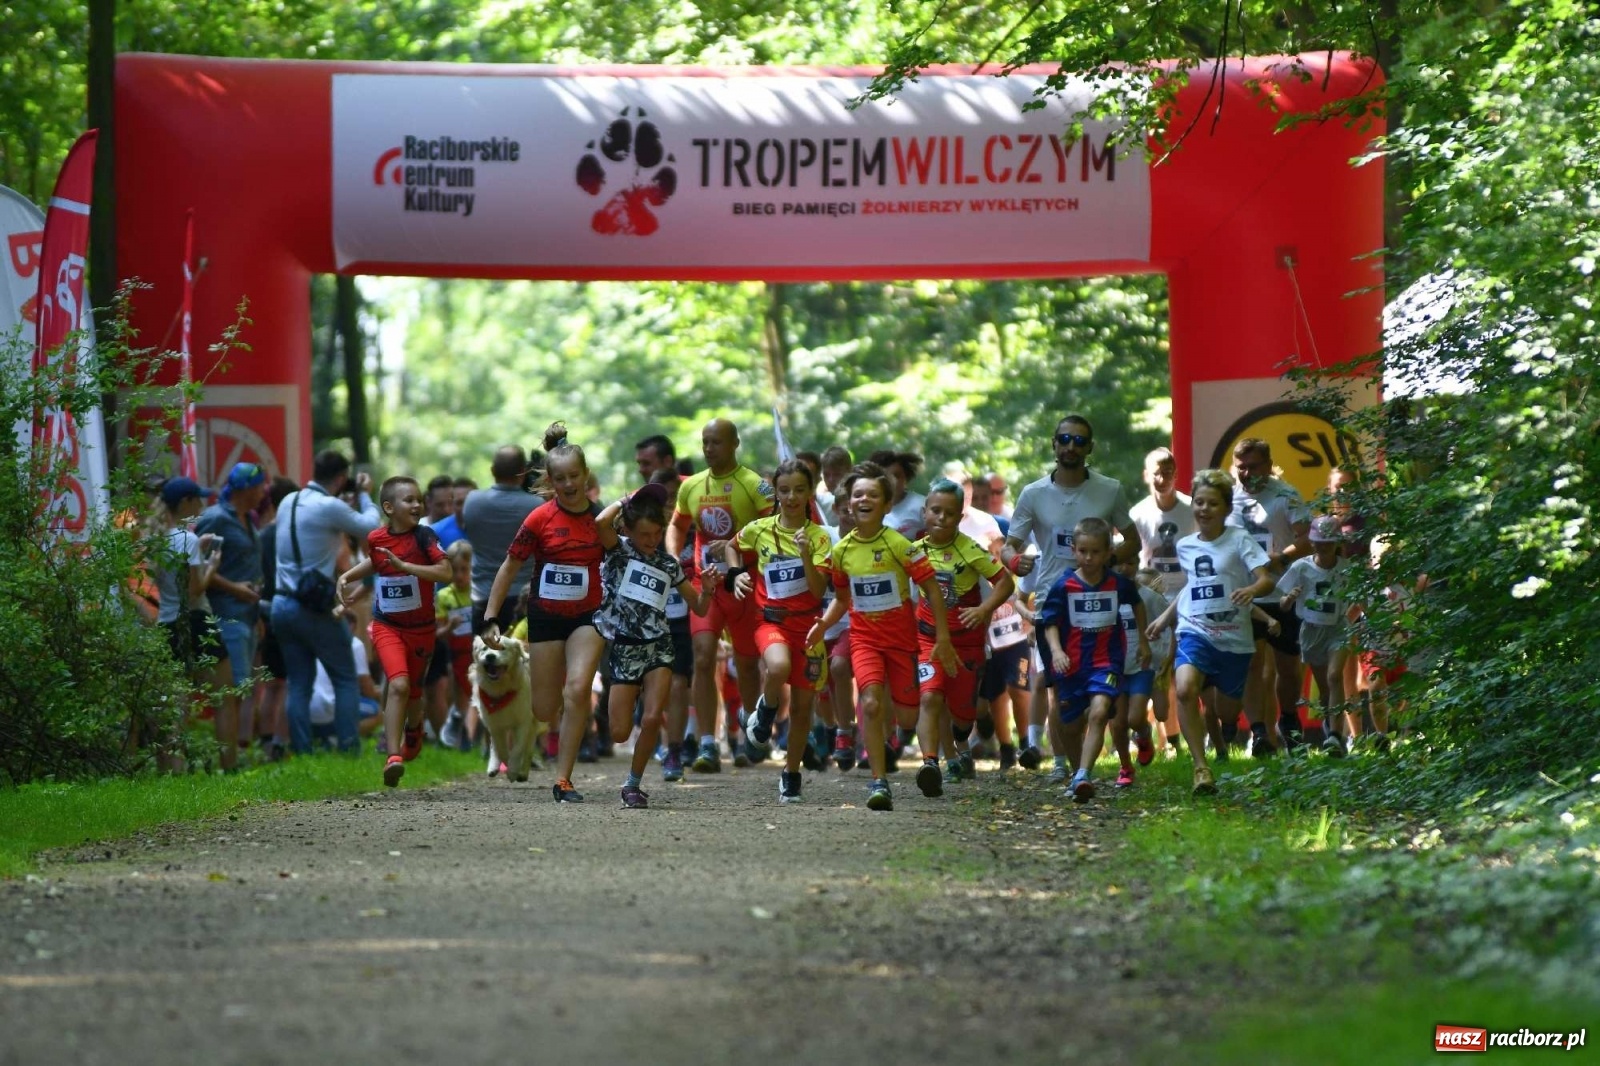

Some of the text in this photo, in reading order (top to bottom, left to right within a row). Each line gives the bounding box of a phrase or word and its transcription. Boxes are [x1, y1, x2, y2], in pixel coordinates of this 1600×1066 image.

[404, 135, 520, 162] Raciborskie
[404, 187, 475, 217] Kultury
[733, 198, 1079, 217] BIEG PAMIĘCI ŻOŁNIERZY WYKLĘTYCH
[554, 573, 572, 584] 83
[779, 568, 796, 580] 97
[639, 574, 658, 589] 96
[387, 587, 403, 597] 82
[863, 583, 880, 595] 87
[1198, 586, 1214, 598] 16
[1084, 600, 1101, 611] 89
[1000, 624, 1013, 635] 24
